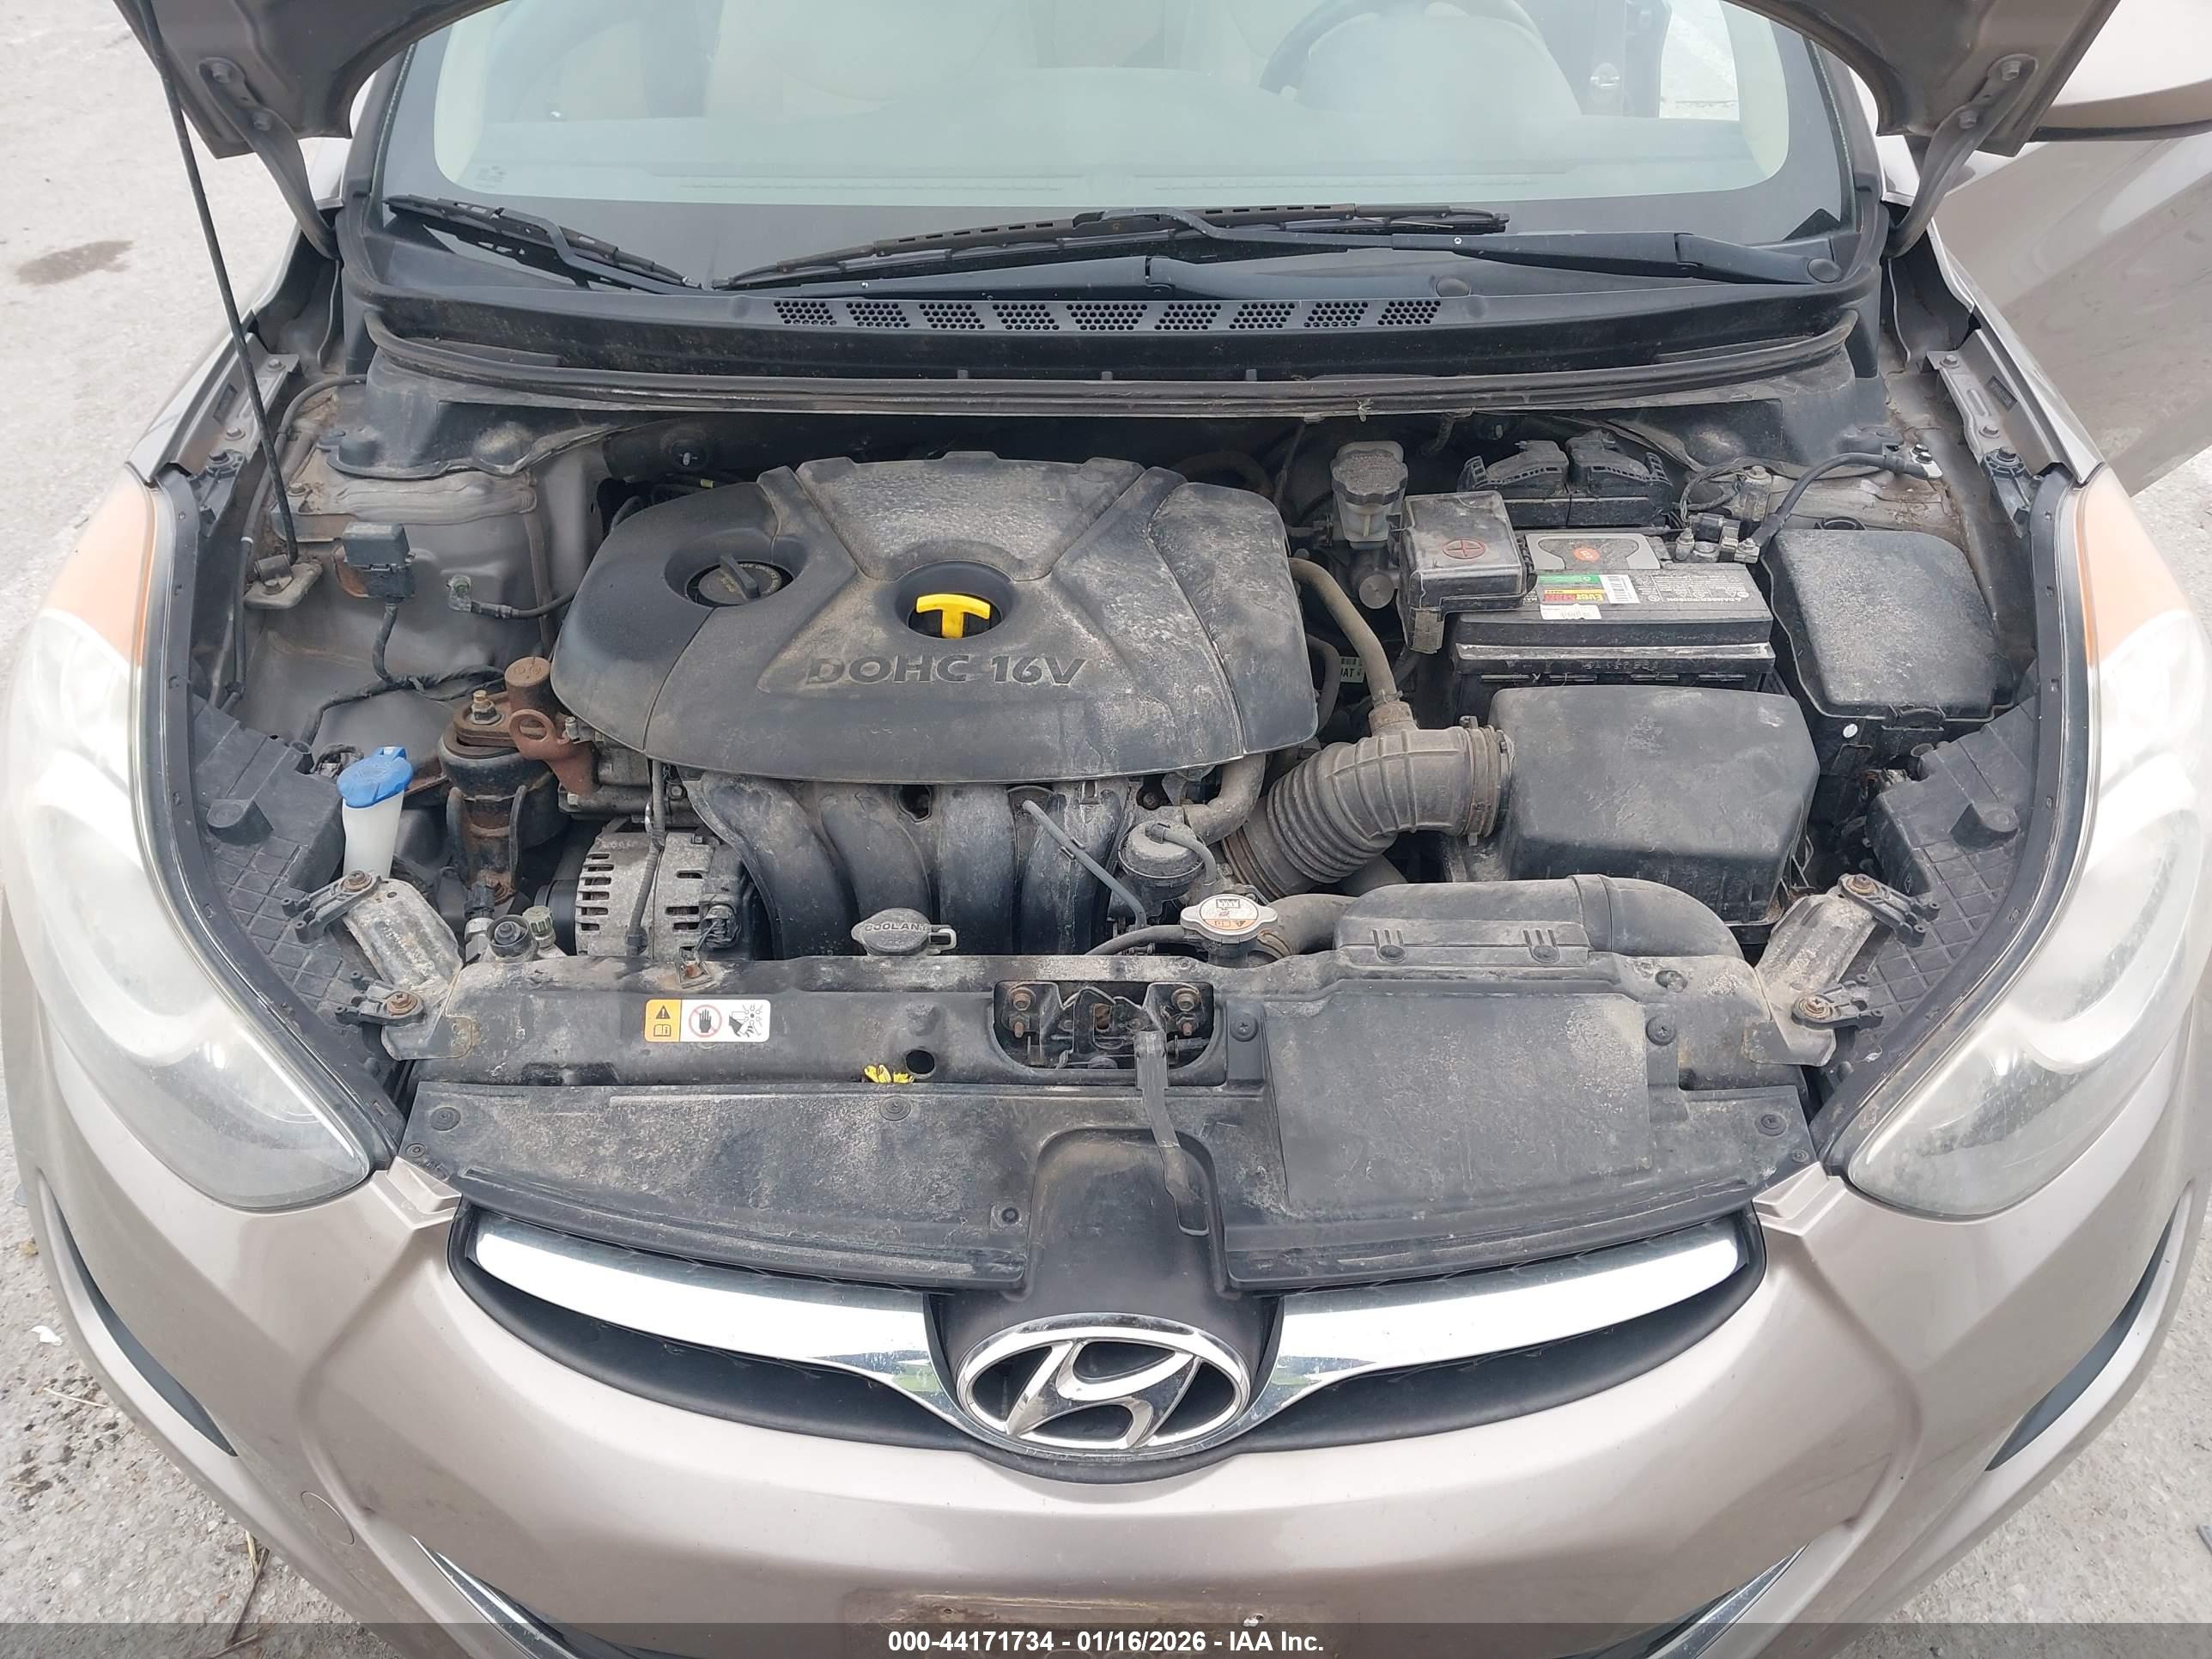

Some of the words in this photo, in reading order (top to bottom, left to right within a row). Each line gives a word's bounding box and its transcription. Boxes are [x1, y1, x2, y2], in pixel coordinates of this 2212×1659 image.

[805, 655, 969, 684] DOHC
[990, 655, 1086, 686] 16V
[864, 921, 931, 933] COOLANT
